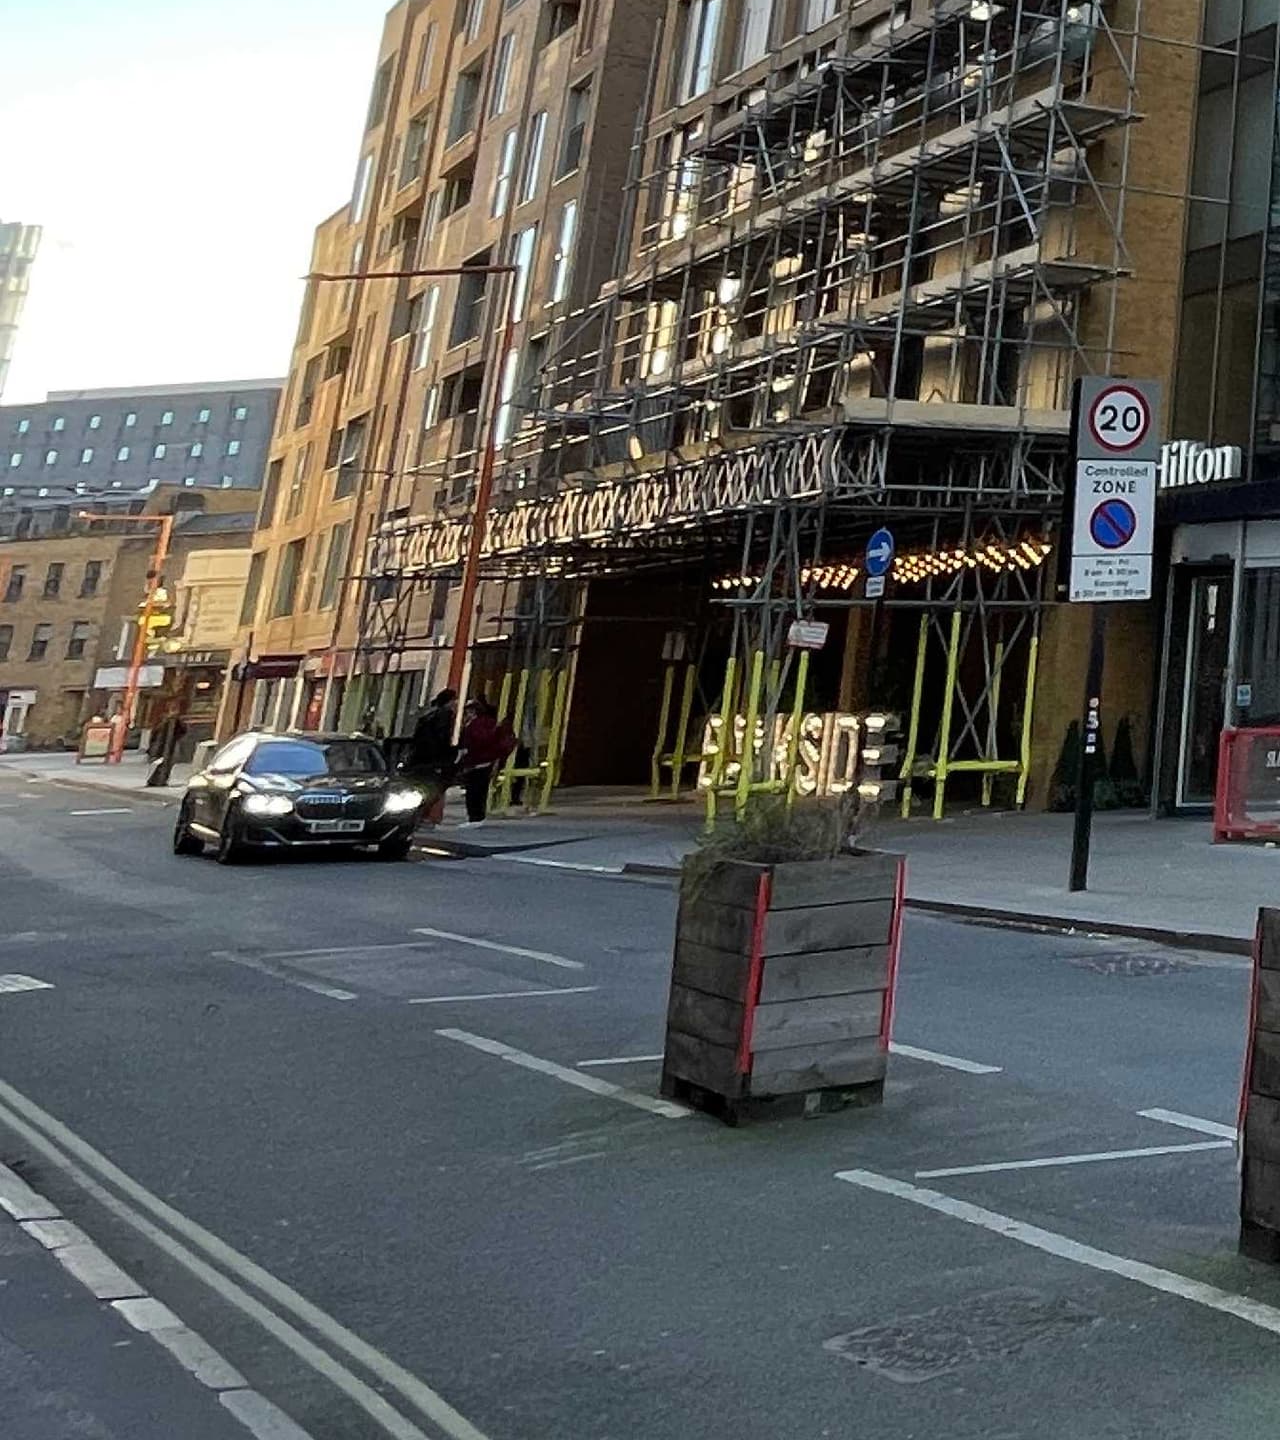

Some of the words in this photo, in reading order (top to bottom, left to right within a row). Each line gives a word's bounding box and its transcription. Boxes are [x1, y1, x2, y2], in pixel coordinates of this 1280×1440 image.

[1100, 405, 1141, 433] 20
[1084, 465, 1149, 478] Controlled
[1092, 480, 1136, 494] ZONE
